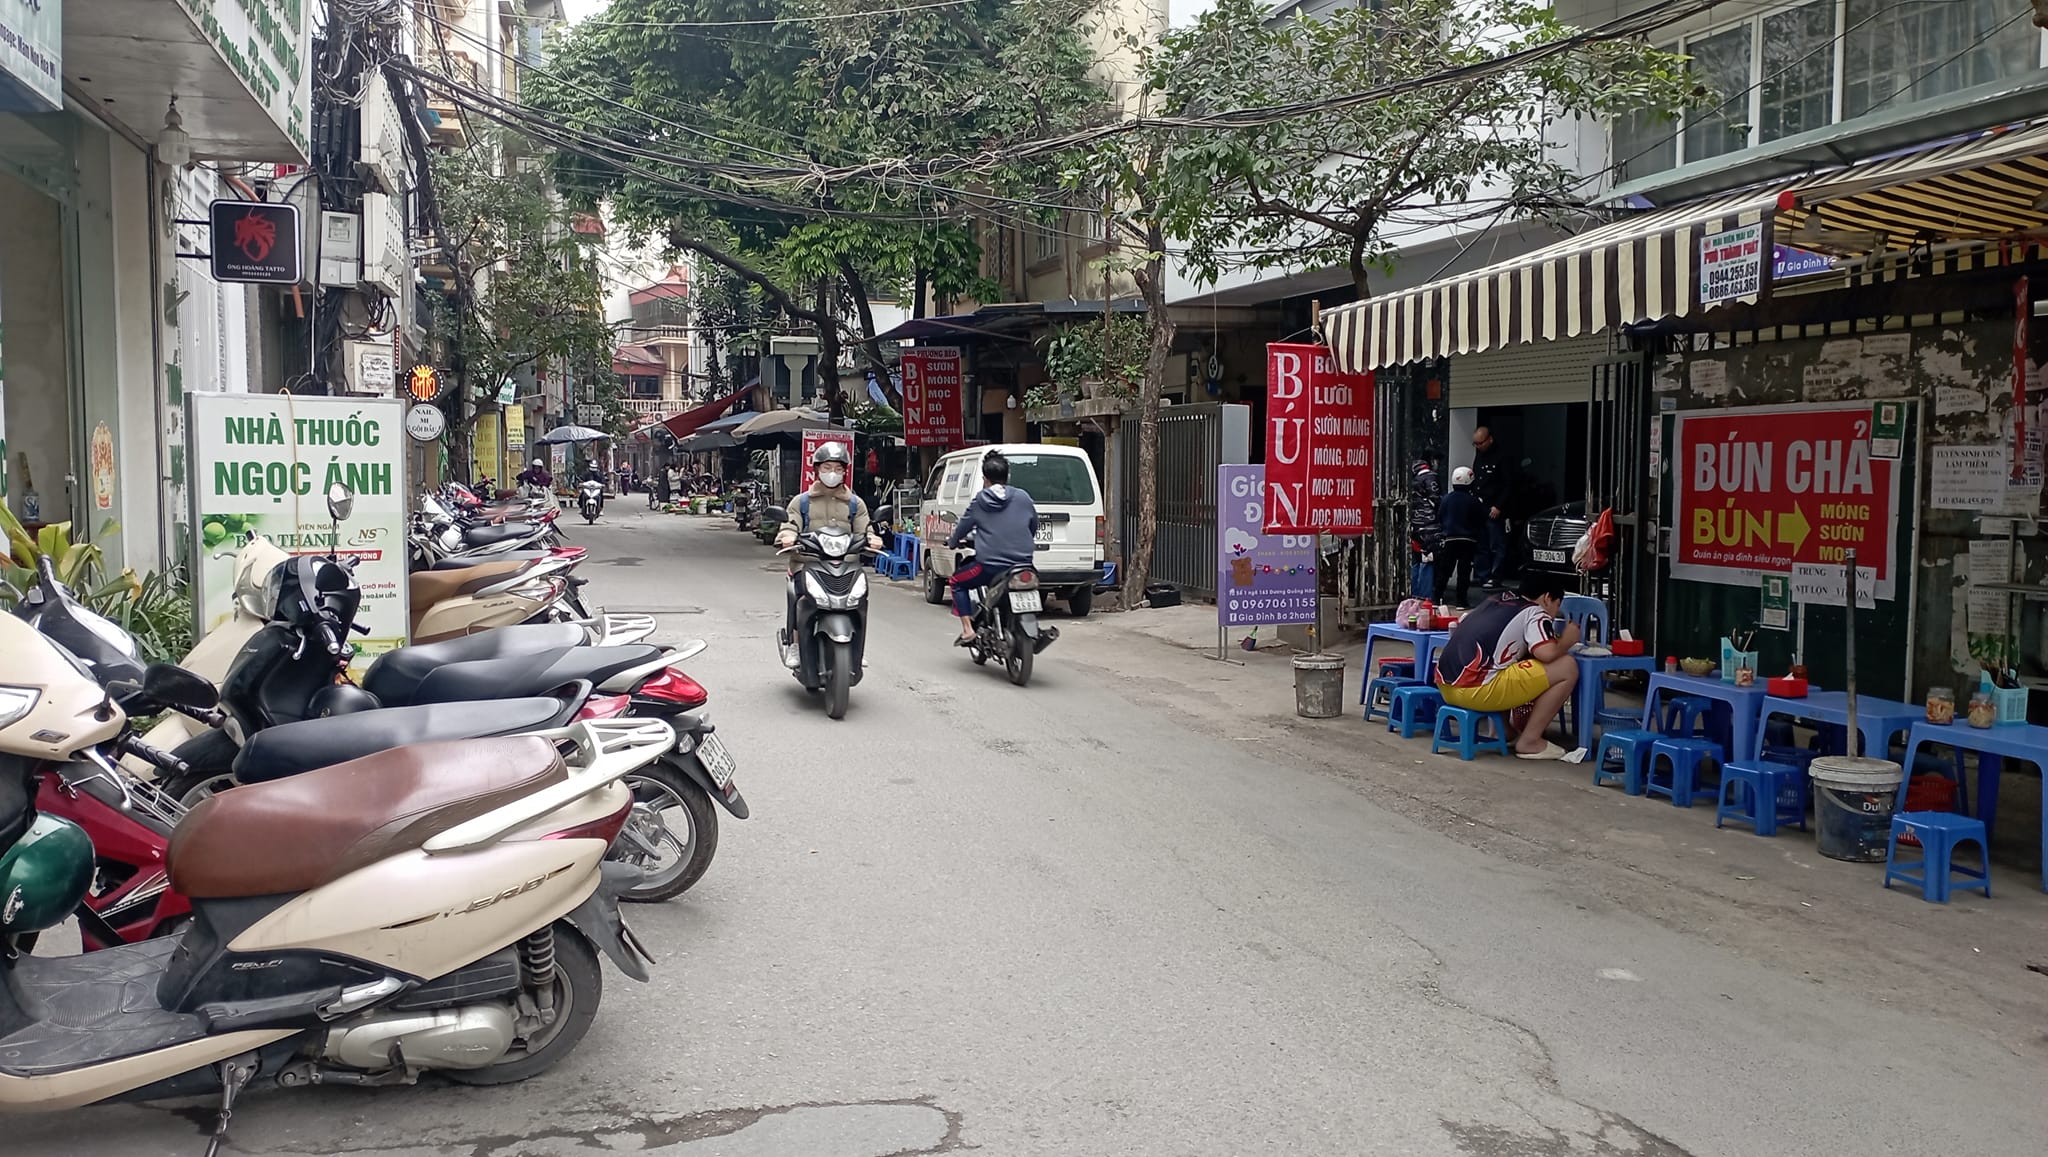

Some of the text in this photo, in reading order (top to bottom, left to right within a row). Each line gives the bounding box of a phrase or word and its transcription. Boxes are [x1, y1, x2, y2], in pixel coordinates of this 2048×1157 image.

[225, 411, 380, 446] NHÀ THUỐC
[1314, 413, 1341, 436] SƯỜN
[1268, 352, 1304, 528] BÚN
[1694, 420, 1873, 494] BÚN CHẢ
[214, 456, 392, 503] NGỌC ÁNH
[1312, 478, 1355, 500] MỌC THỊT
[1311, 508, 1332, 528] DỌC
[1820, 501, 1870, 520] MÓNG
[358, 528, 377, 539] NS
[1693, 498, 1772, 549] BÚN
[1820, 522, 1864, 542] SƯỜN
[1819, 546, 1847, 564] MỌ
[1242, 598, 1316, 609] 0967061155
[1256, 612, 1274, 620] Đình
